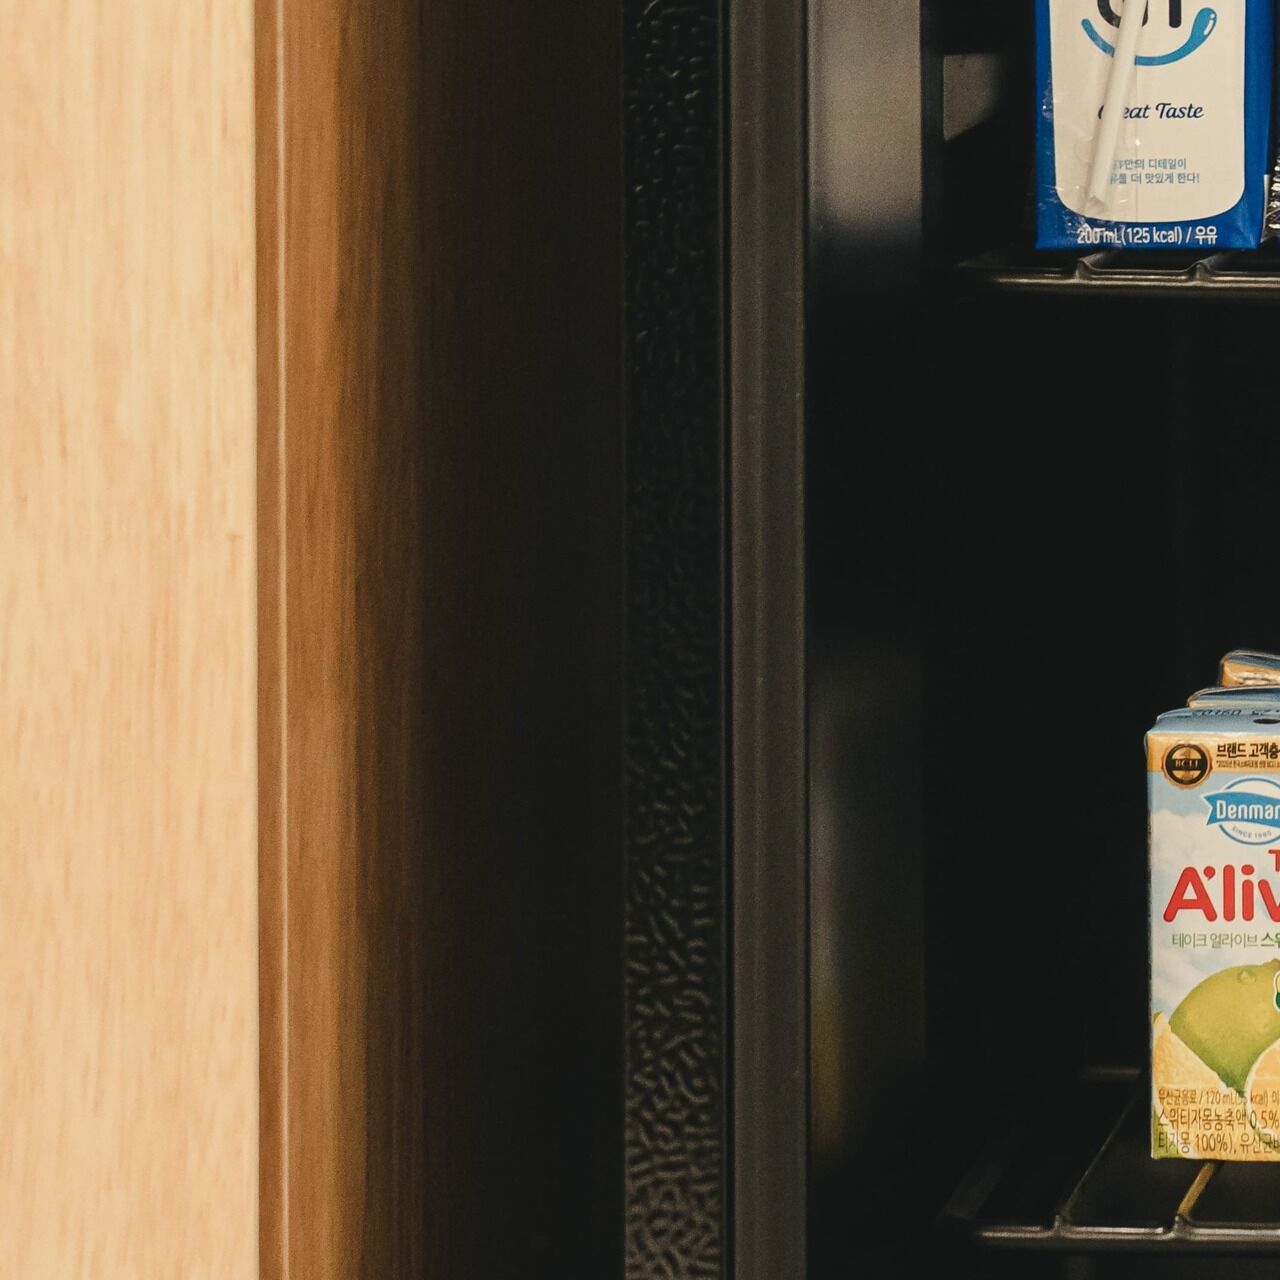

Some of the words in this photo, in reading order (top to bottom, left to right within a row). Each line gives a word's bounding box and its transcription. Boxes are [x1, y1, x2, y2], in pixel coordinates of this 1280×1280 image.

[1156, 102, 1204, 119] Taste
[1077, 227, 1100, 243] 200
[1153, 226, 1182, 243] kcal)
[1195, 226, 1217, 245] 우유
[1216, 743, 1247, 758] 브랜드
[1172, 932, 1208, 949] 테이크
[1211, 932, 1258, 948] 얼라이브
